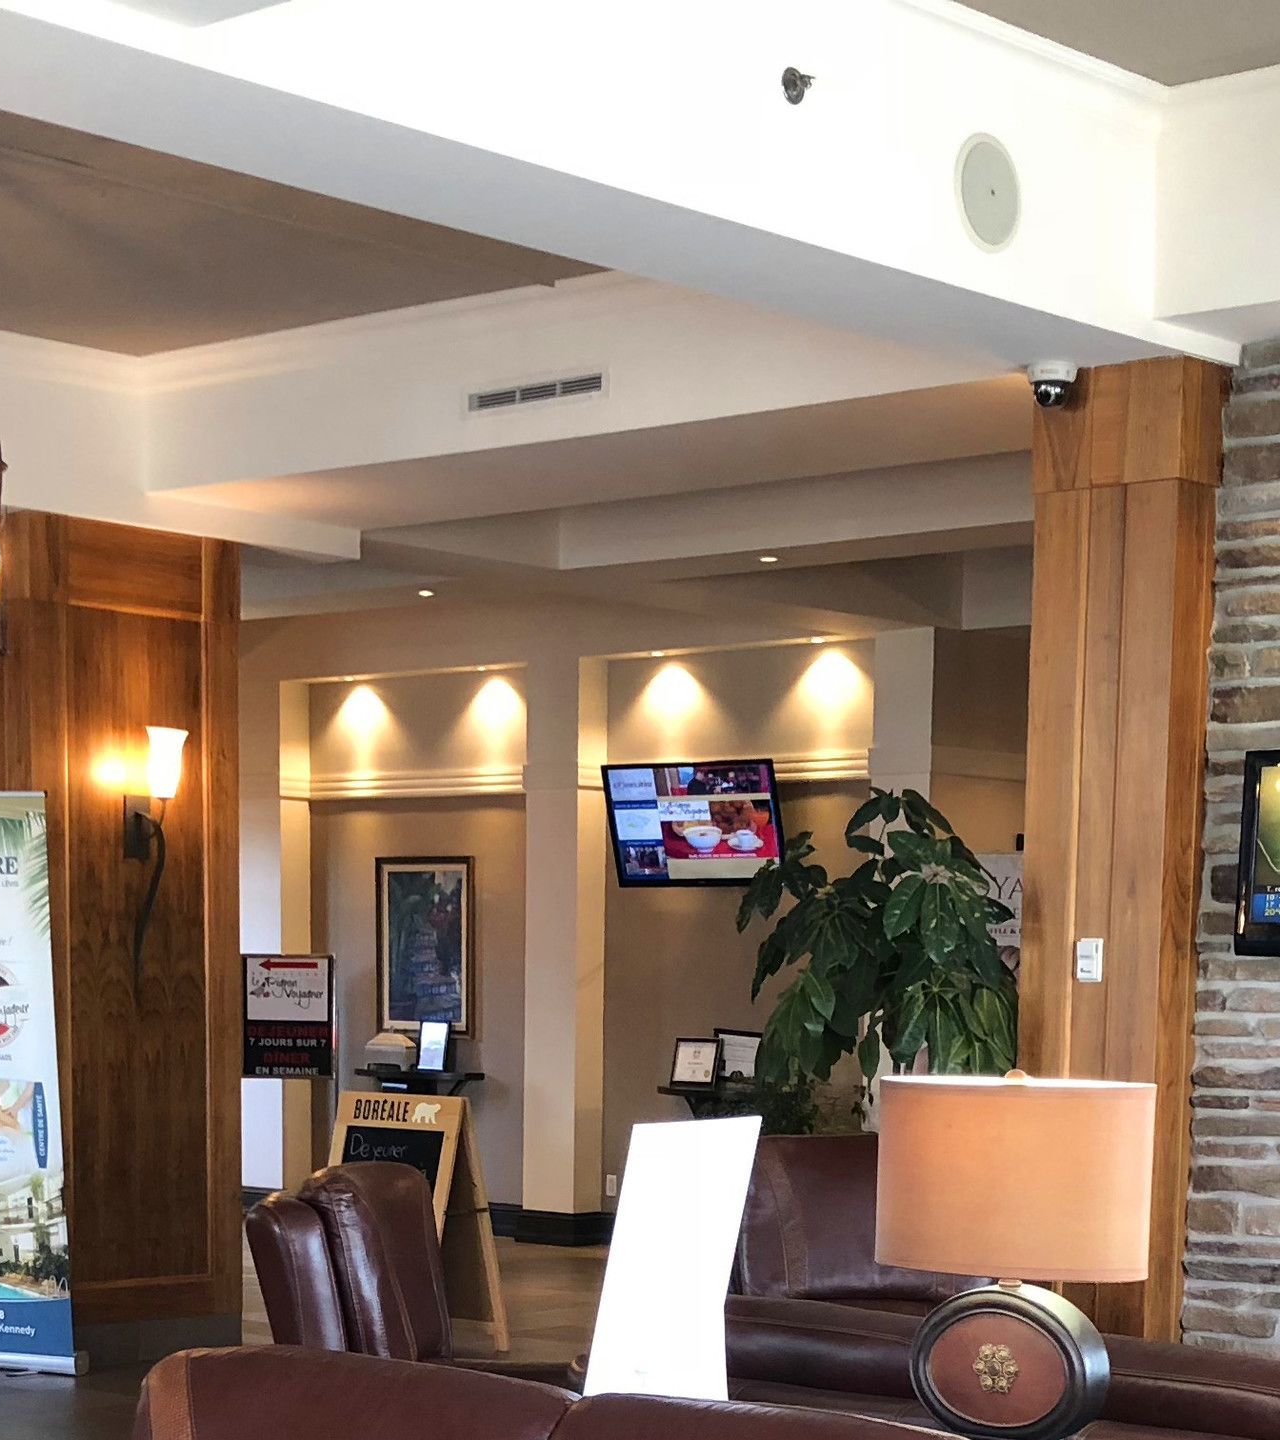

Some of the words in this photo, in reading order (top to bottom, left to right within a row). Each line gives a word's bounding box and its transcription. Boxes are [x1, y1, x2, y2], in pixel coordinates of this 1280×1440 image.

[248, 1037, 256, 1047] 7
[258, 1038, 293, 1047] JOURS
[296, 1038, 318, 1048] SUR
[320, 1039, 327, 1048] 7
[255, 1066, 270, 1075] EN
[272, 1066, 320, 1076] SEMAINE
[36, 1094, 44, 1117] SANTÉ
[353, 1098, 411, 1123] BORÉALE
[37, 1118, 45, 1128] DE
[37, 1129, 46, 1157] CENTRE
